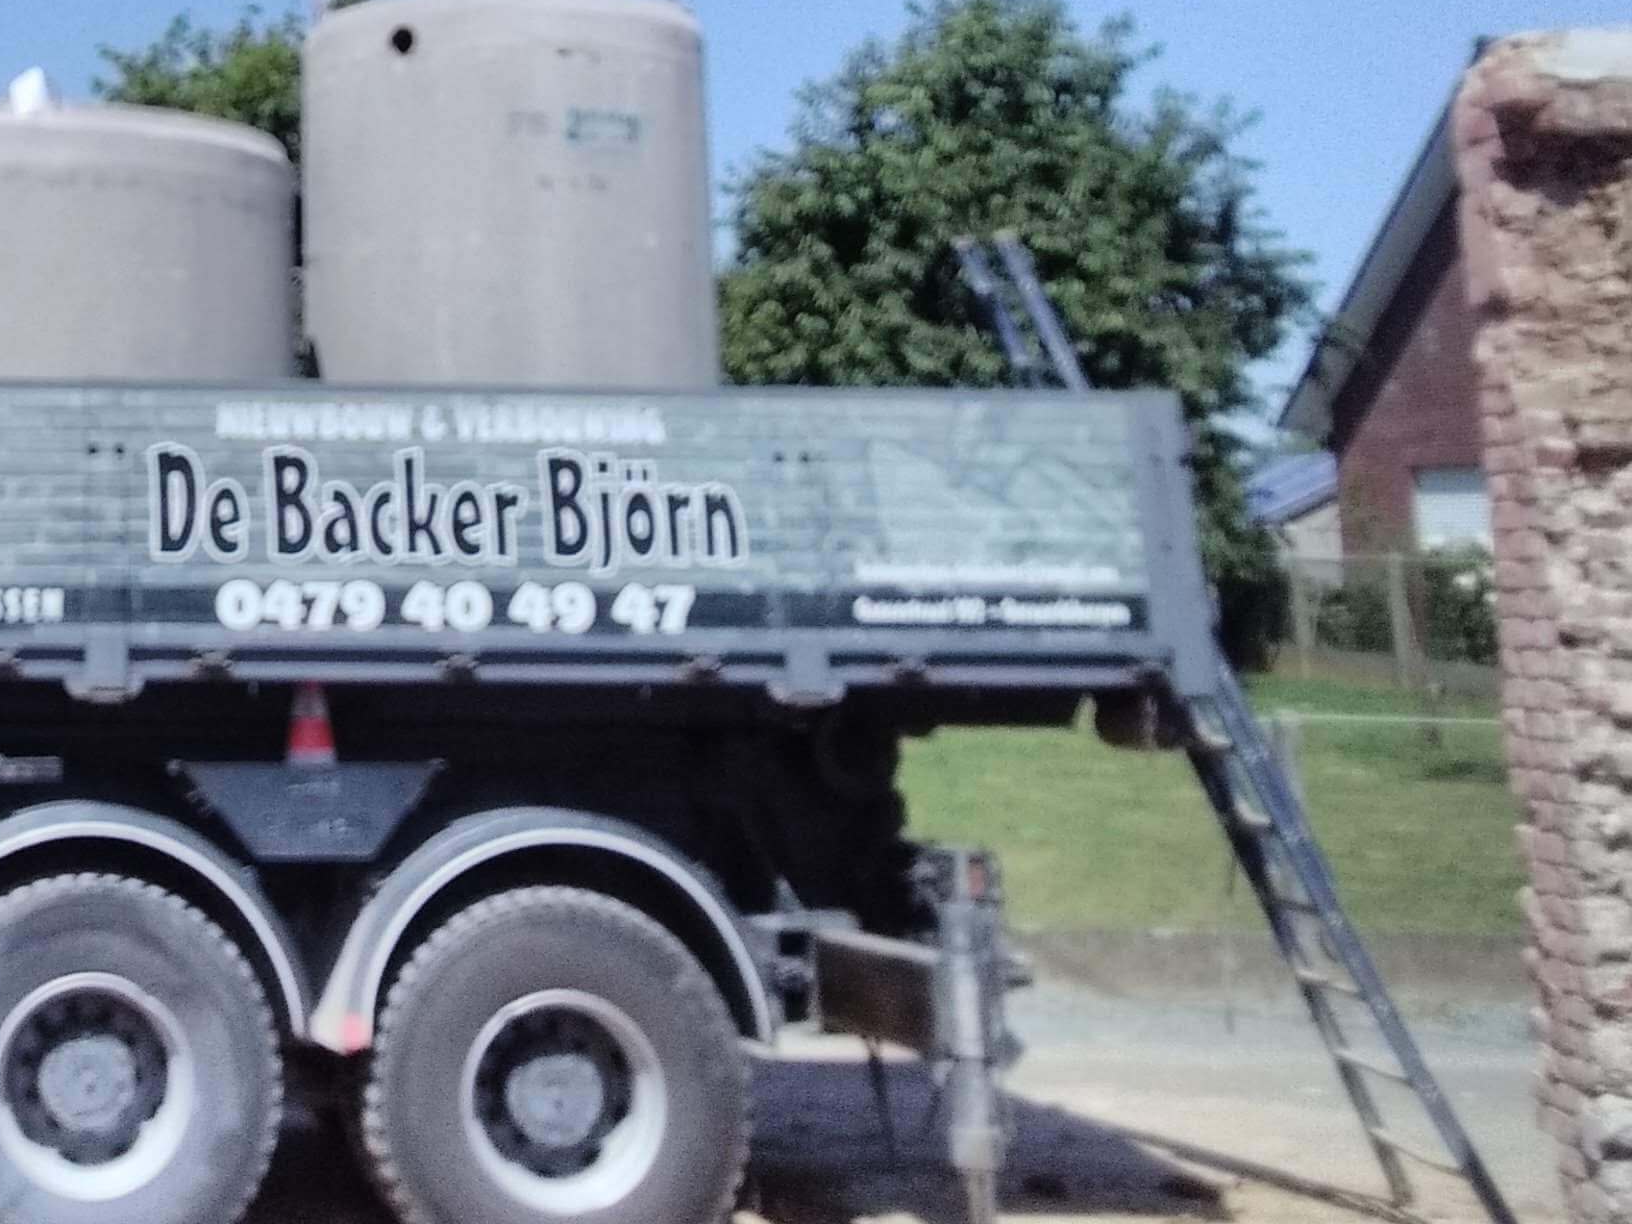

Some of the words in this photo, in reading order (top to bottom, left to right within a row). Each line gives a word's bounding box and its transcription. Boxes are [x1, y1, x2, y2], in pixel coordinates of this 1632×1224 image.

[421, 404, 447, 443] &
[153, 447, 245, 557] De
[269, 450, 521, 558] Backer
[543, 454, 740, 570] Björn
[215, 579, 386, 632] 0479
[400, 579, 494, 633] 40
[507, 580, 597, 634] 49
[609, 581, 696, 635] 47
